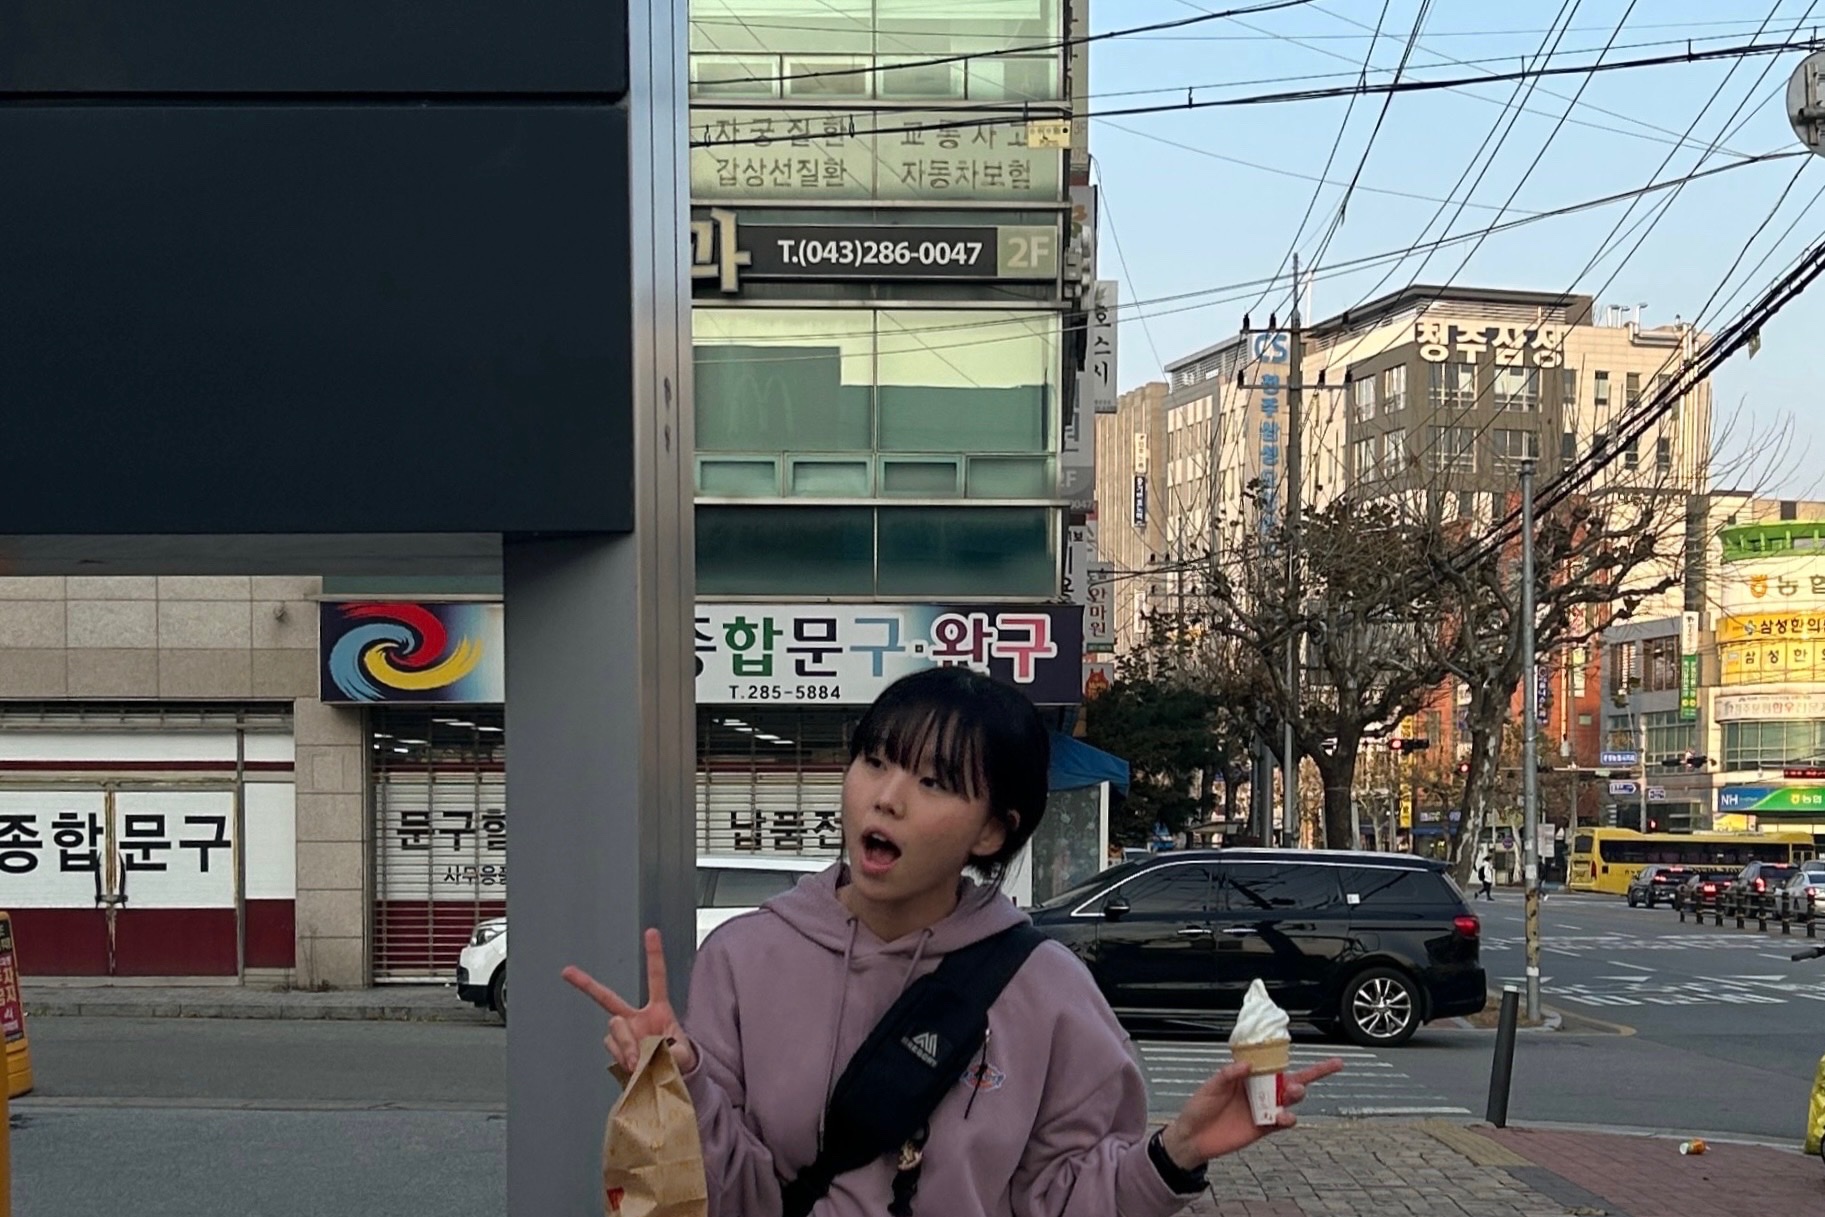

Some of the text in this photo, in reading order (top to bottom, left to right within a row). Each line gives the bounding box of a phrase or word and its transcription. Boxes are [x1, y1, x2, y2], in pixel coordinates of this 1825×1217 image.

[715, 157, 848, 188] 갑상선질환
[900, 159, 1031, 190] 자동차보험
[777, 239, 983, 268] T.(043)286-0047
[1007, 236, 1051, 268] 2F
[1760, 618, 1825, 634] 삼성한의
[728, 684, 841, 700] T.285-5884
[1720, 793, 1739, 806] NH
